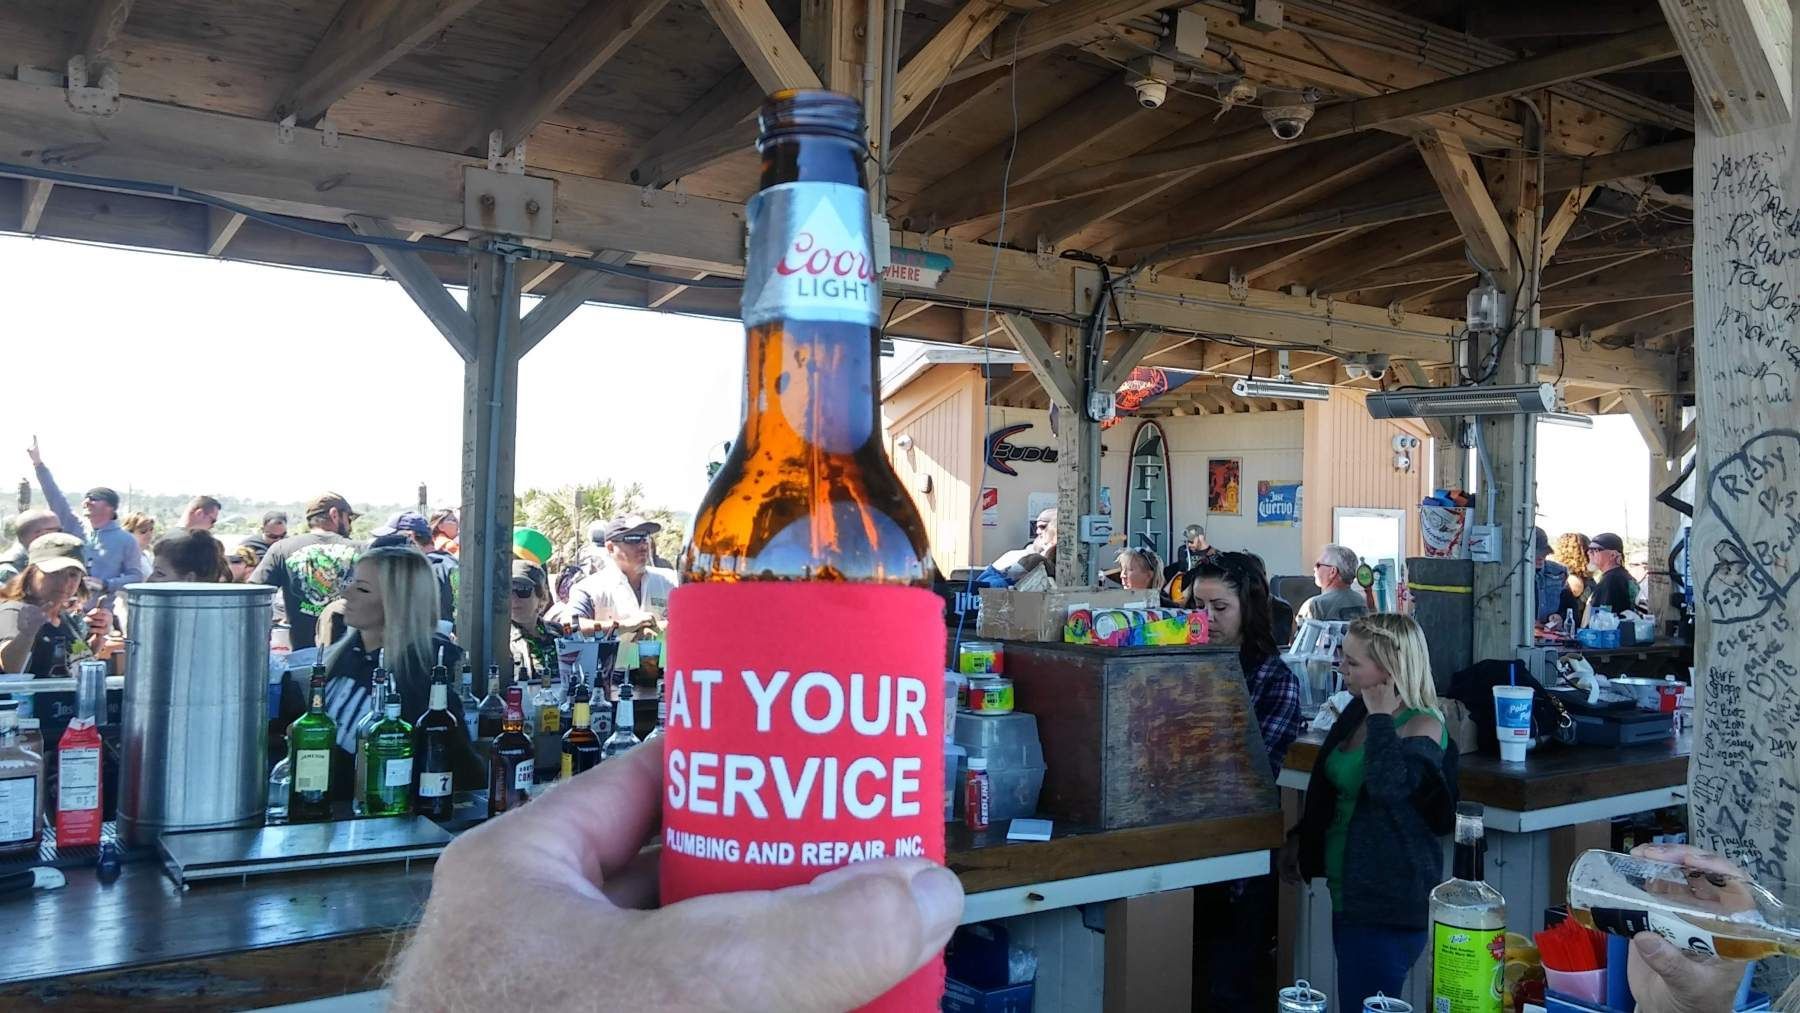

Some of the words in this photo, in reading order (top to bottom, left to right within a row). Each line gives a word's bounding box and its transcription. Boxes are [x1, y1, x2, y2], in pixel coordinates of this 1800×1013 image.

[798, 278, 869, 302] LIGHT
[669, 670, 722, 730] AT
[741, 670, 928, 737] YOUR
[668, 749, 921, 820] SERVICE
[667, 829, 740, 863] PLUMBING
[745, 841, 795, 865] AND
[895, 835, 925, 857] INC.
